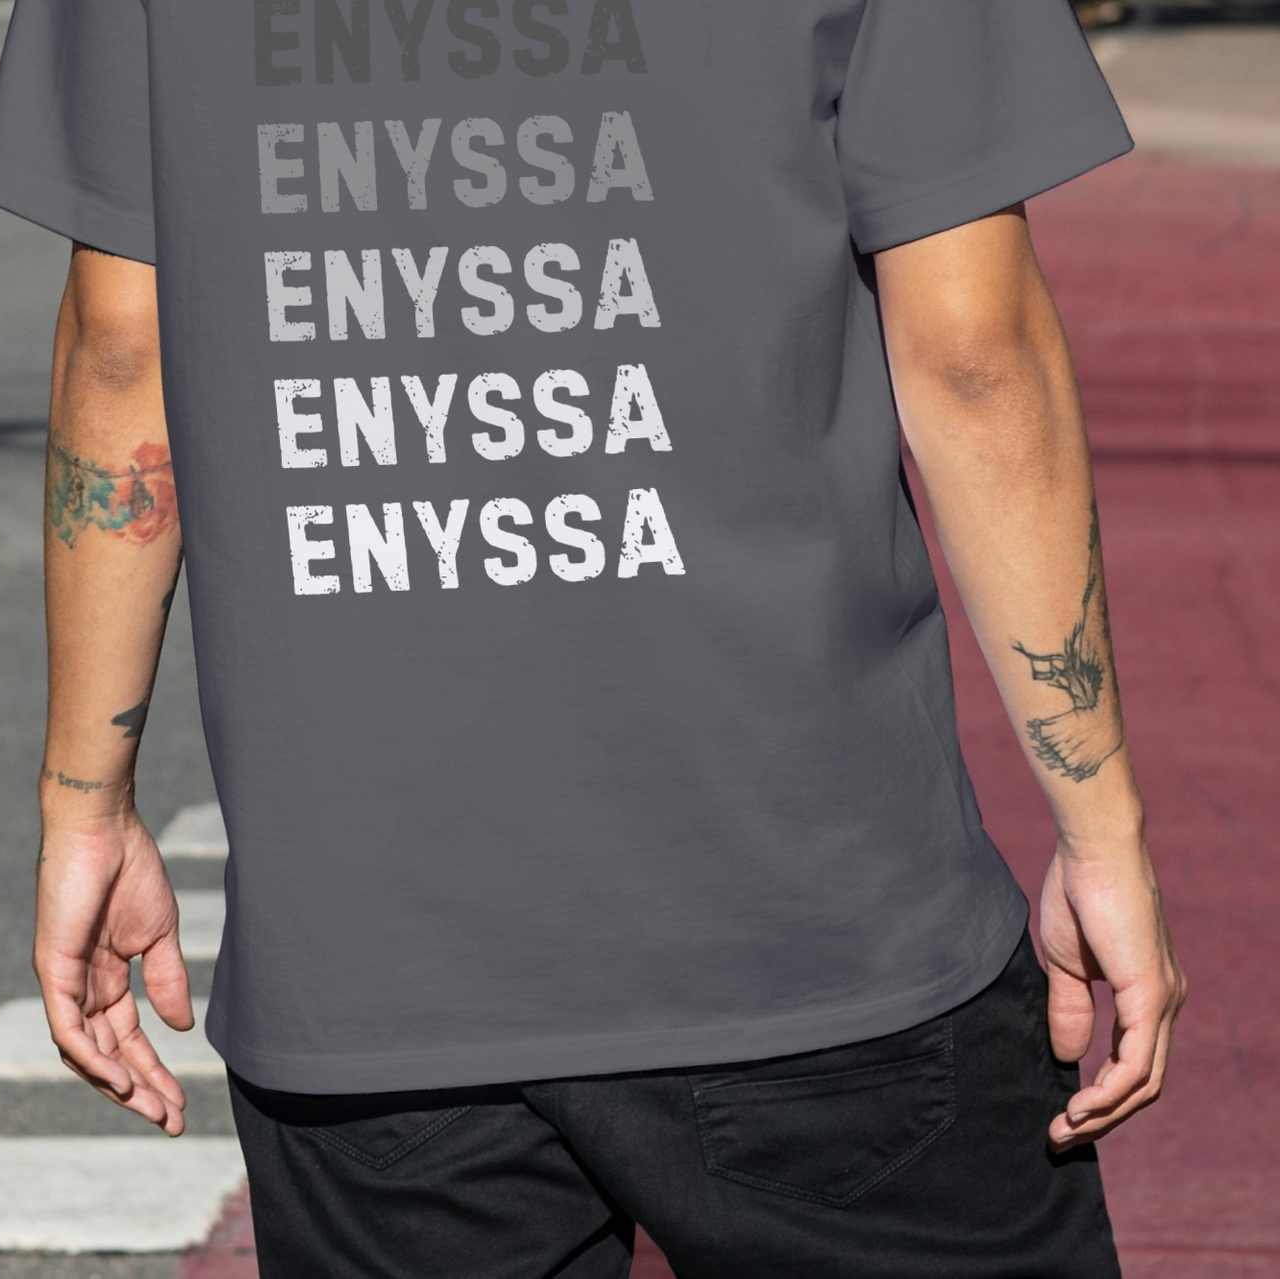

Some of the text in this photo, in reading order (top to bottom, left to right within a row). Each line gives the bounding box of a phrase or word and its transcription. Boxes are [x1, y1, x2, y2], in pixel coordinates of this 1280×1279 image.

[257, 110, 655, 214] ENYSSA
[263, 237, 662, 342] ENYSSA
[273, 363, 673, 468] ENYSSA
[285, 487, 687, 596] ENYSSA
